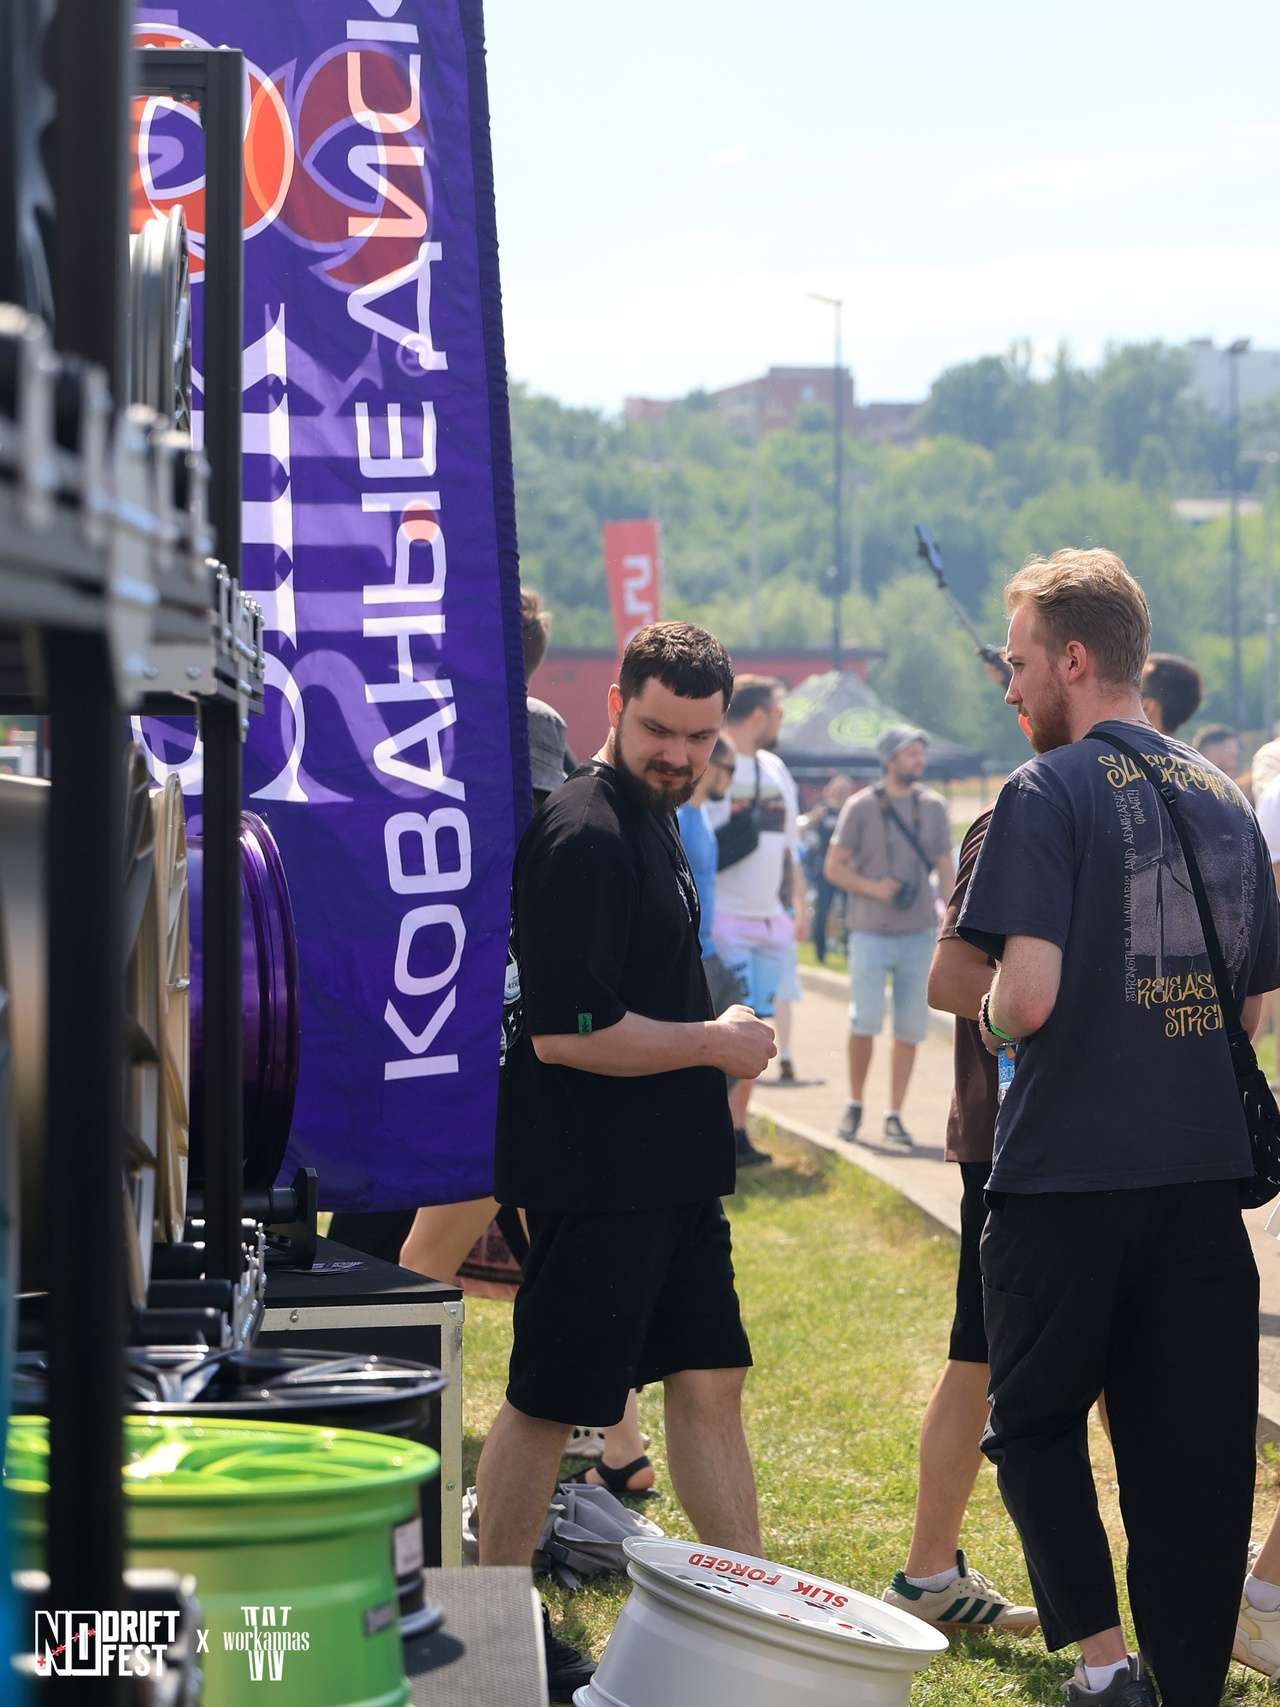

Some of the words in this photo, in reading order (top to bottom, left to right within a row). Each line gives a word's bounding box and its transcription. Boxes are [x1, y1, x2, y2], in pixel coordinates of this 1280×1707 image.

[356, 400, 472, 1081] КОВАНЫЕ
[1137, 974, 1218, 1010] RELEAS
[688, 1552, 782, 1586] FORGED
[791, 1580, 850, 1608] SLIK
